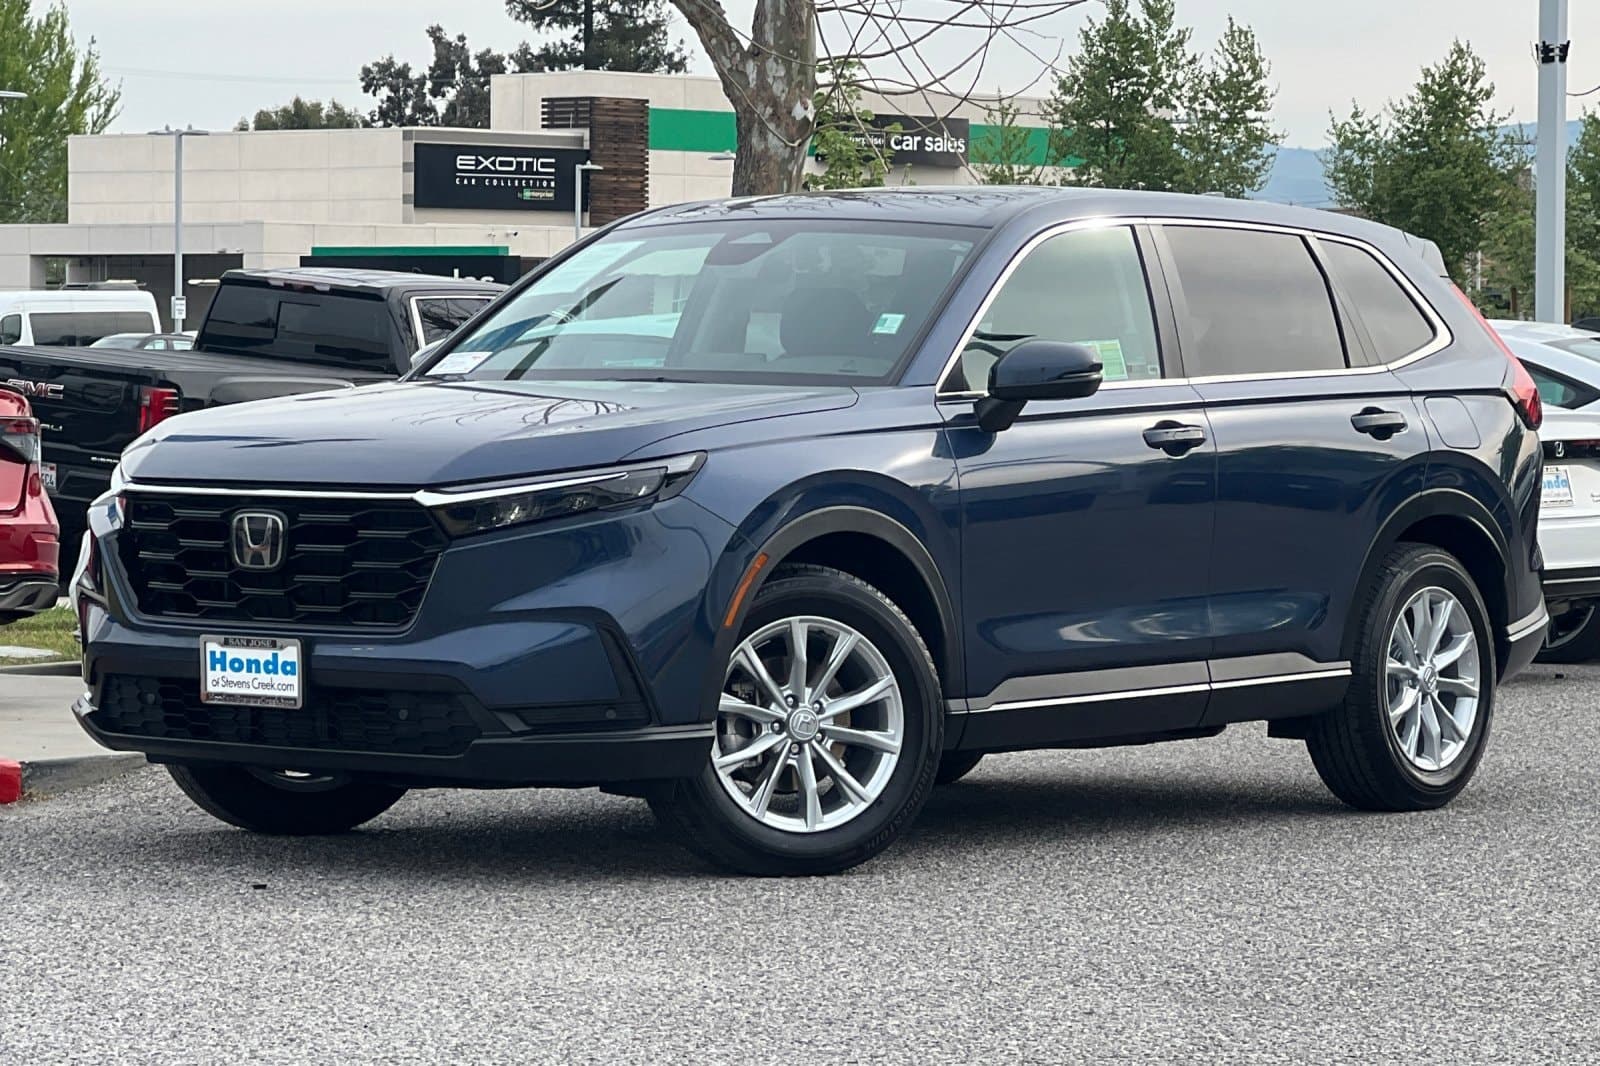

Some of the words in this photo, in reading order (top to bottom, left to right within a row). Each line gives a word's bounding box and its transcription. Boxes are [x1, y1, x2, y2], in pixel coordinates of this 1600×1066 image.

[890, 135, 921, 150] car
[925, 131, 965, 152] sales
[456, 155, 556, 172] EXOTIC
[485, 178, 555, 188] COLLECTION
[228, 638, 247, 646] SAN
[249, 639, 273, 648] JOSE
[209, 650, 297, 676] Honda
[211, 678, 220, 688] of
[221, 676, 250, 688] Stevens
[251, 677, 294, 692] Creek.com
